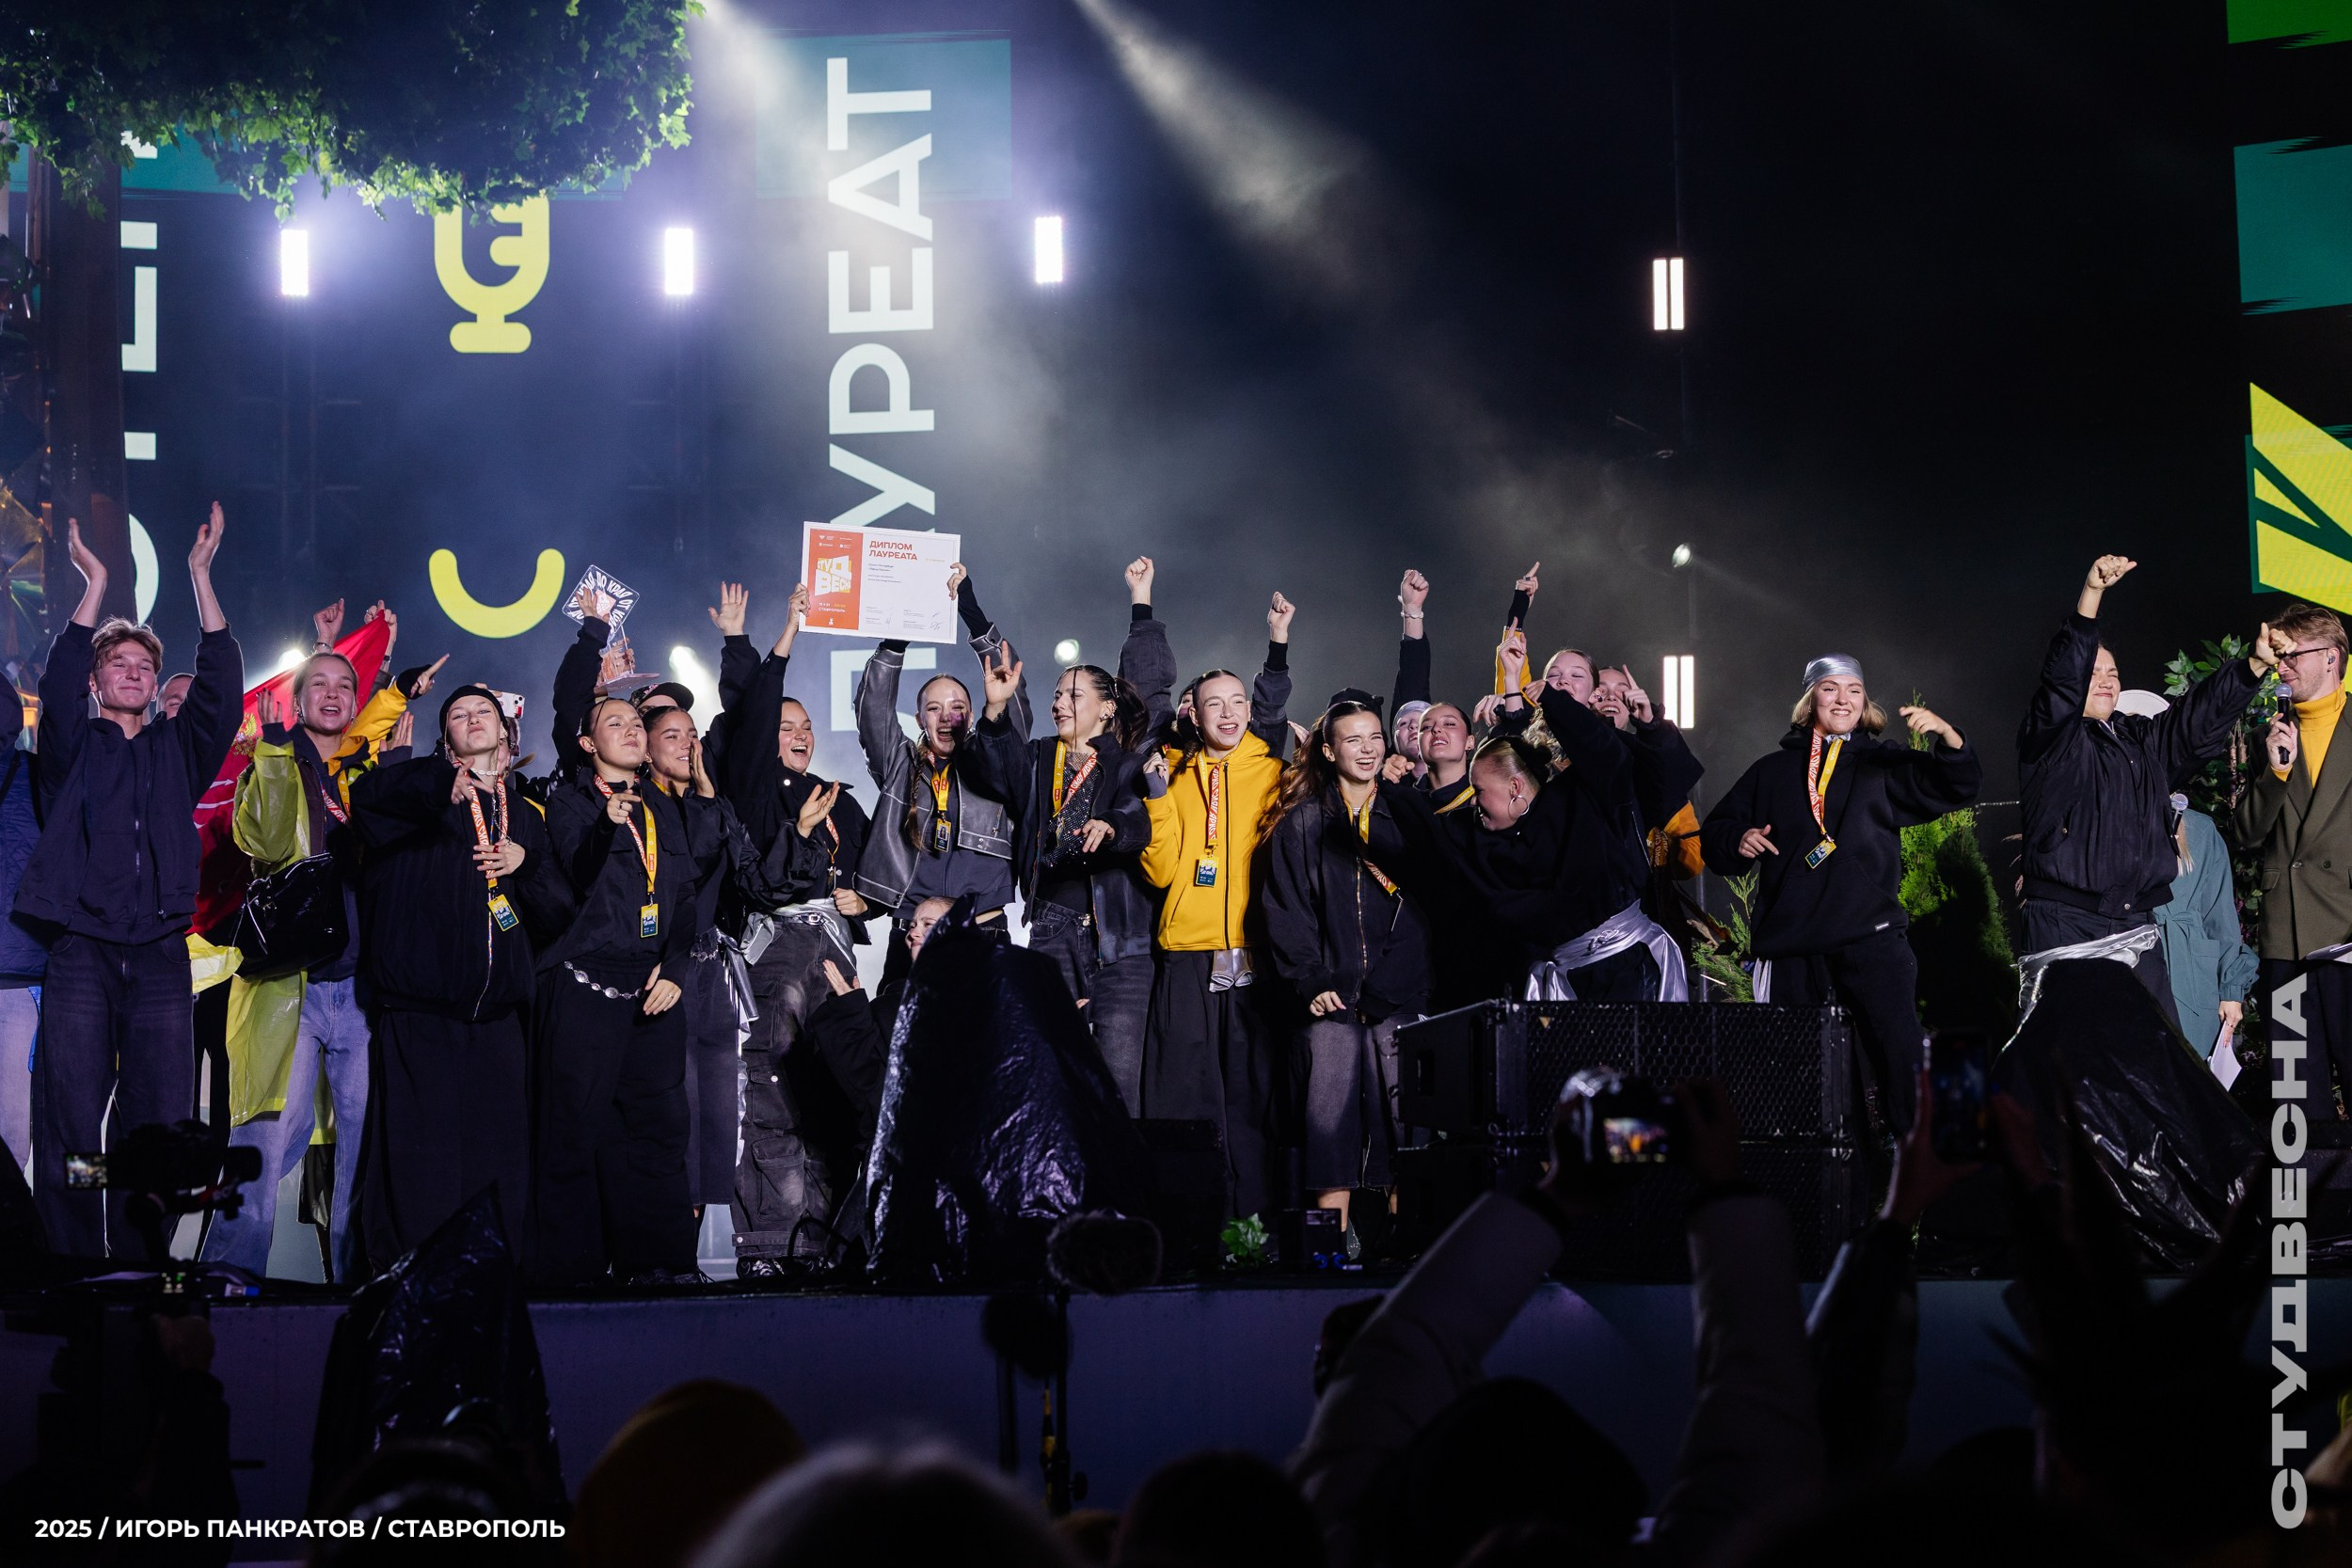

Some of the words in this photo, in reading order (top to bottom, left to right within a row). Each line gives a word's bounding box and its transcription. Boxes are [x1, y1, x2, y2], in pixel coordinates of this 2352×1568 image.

[827, 57, 937, 750] ЛУРЕАТ
[869, 540, 913, 550] ДИПЛОМ
[868, 550, 918, 561] ЛАУРЕАТА
[596, 571, 607, 588] ДО
[607, 579, 633, 599] КРАЯ
[616, 599, 634, 610] ОТ
[1810, 755, 1820, 780] ЯРКО
[1211, 768, 1219, 790] ЯРКО
[1208, 812, 1218, 836] ЯРКО
[477, 826, 489, 847] СИЯ
